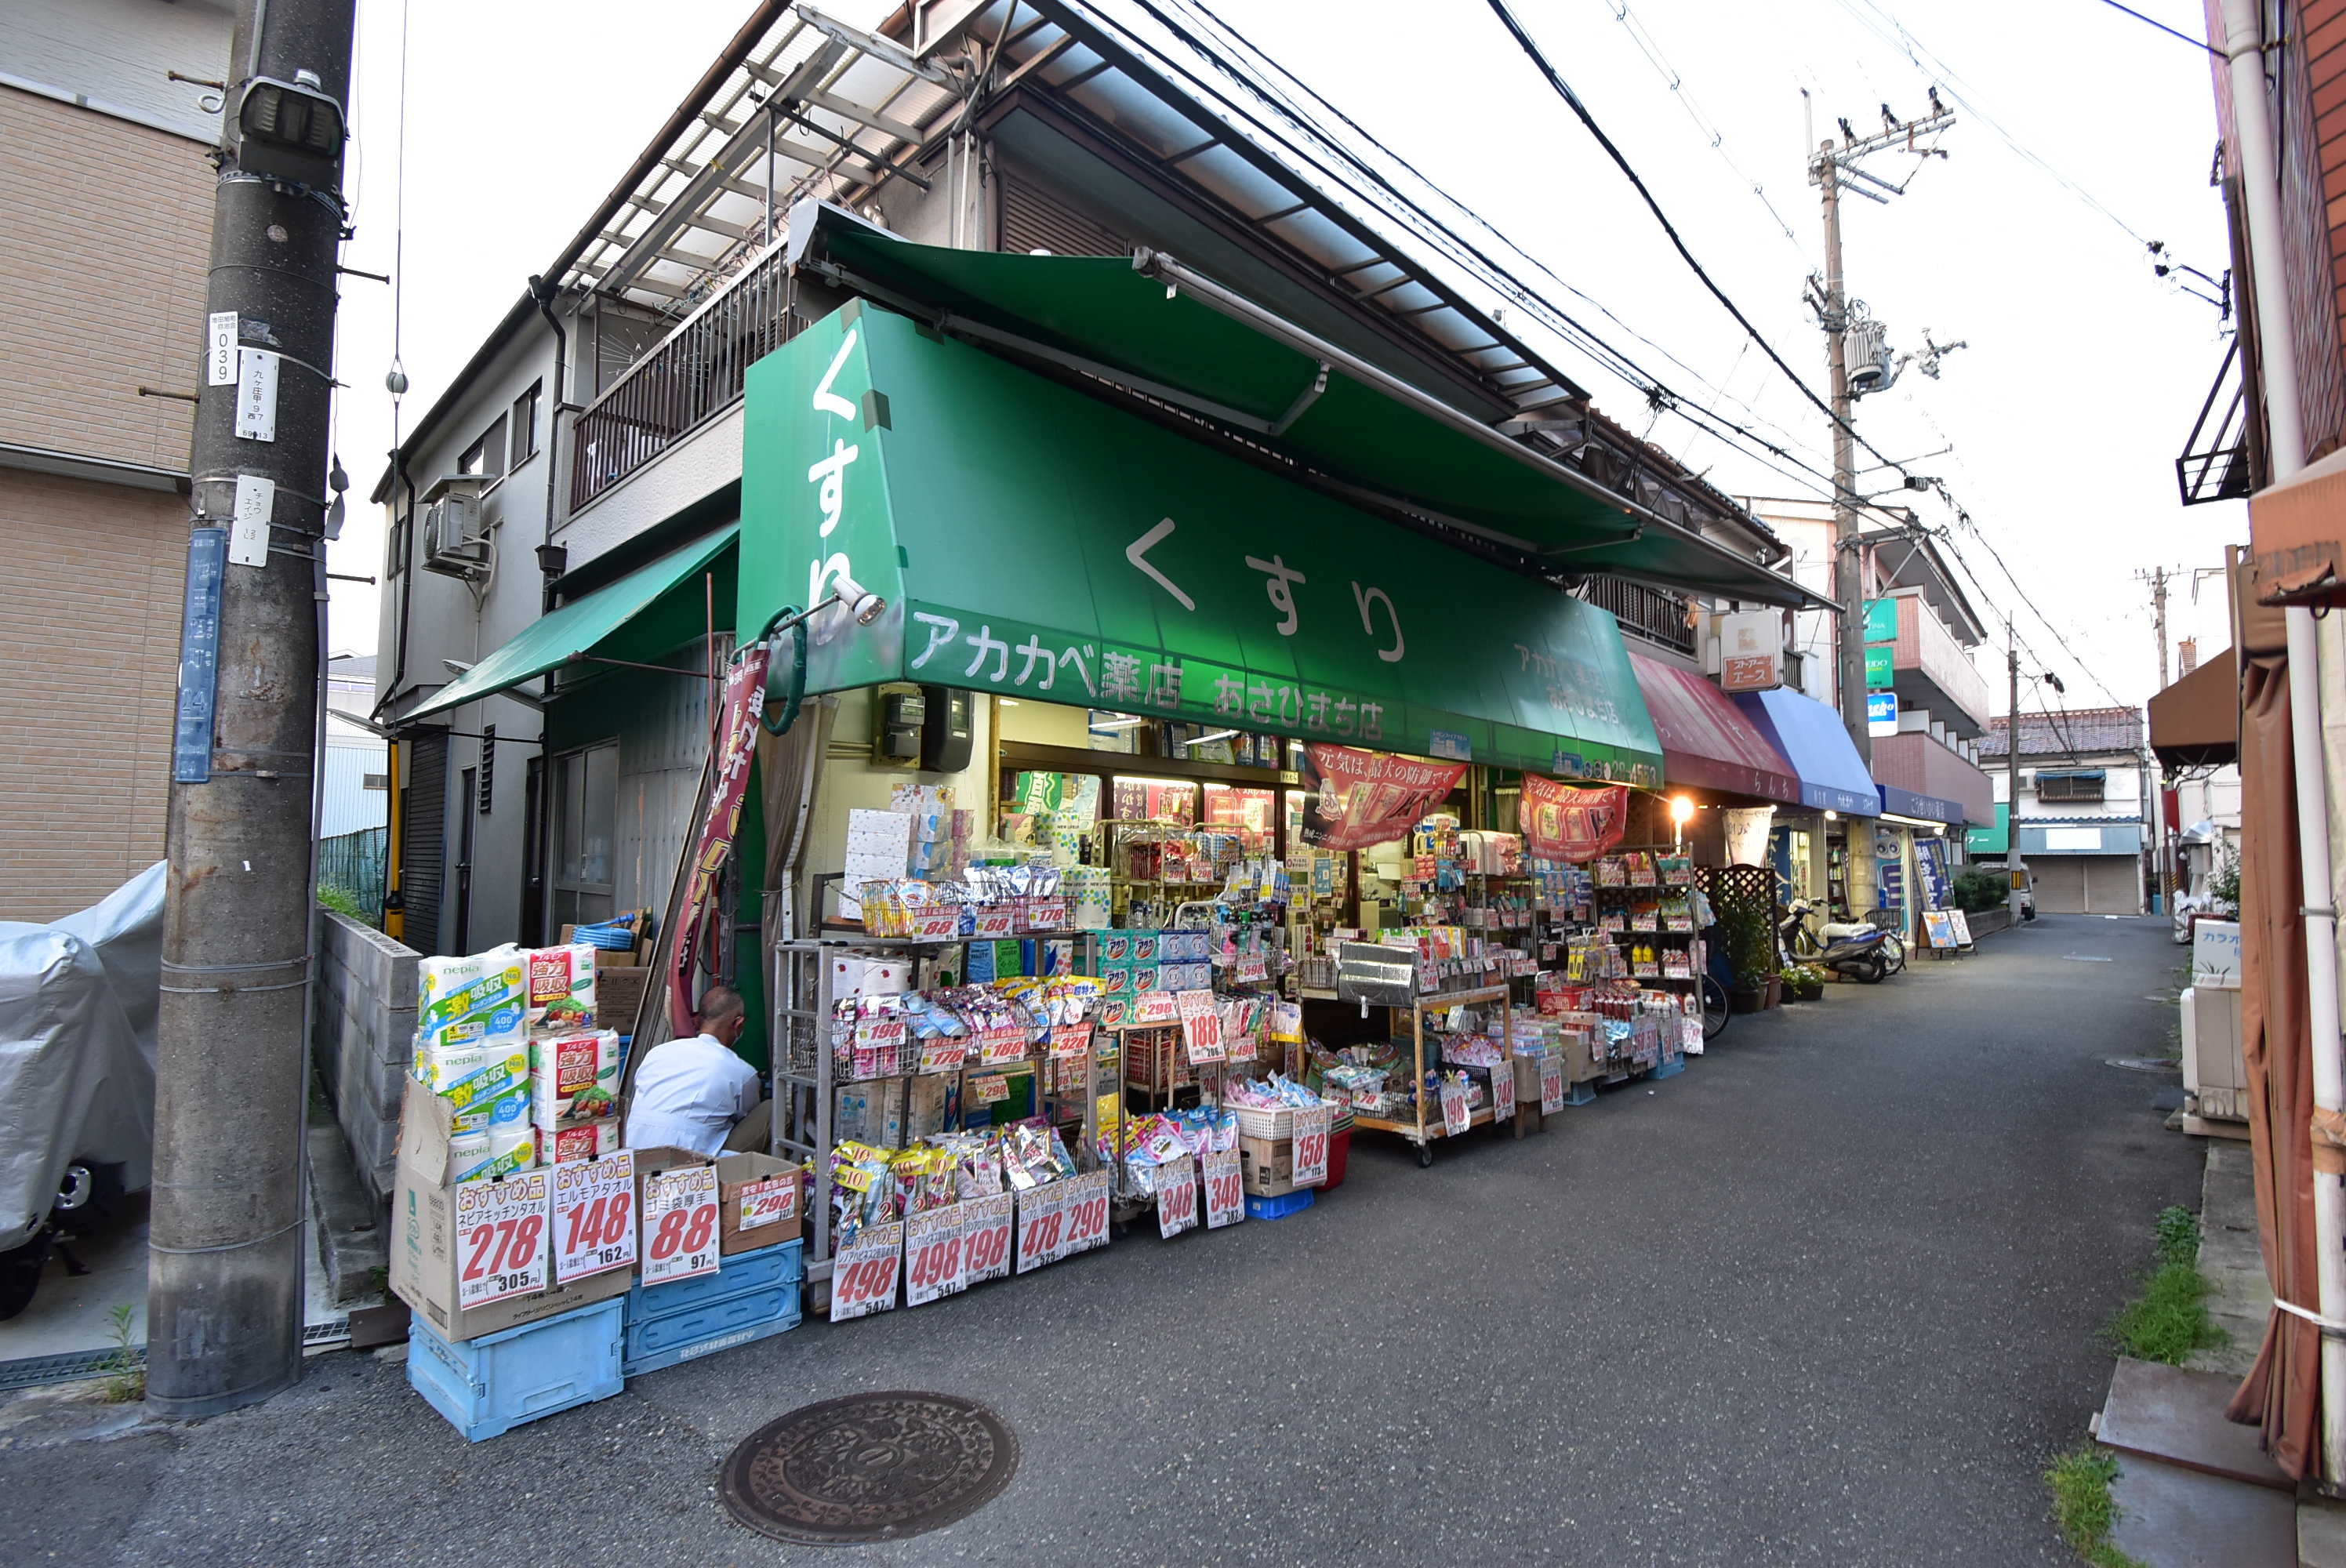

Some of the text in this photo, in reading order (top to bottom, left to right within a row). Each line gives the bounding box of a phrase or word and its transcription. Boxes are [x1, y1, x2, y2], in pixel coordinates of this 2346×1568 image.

[219, 333, 227, 379] 039
[808, 328, 859, 645] くすり
[254, 493, 263, 514] チョウ
[1126, 517, 1404, 662] くすり
[912, 612, 1183, 709] アカカベ薬店
[1733, 670, 1766, 683] エース
[182, 688, 207, 711] 24
[1214, 673, 1383, 741] あさひまち店
[1319, 746, 1453, 786] 元気は、最大の防御です
[1755, 771, 1788, 799] らんち
[984, 918, 1008, 931] 88
[1039, 909, 1064, 922] 178
[924, 920, 953, 935] 88
[444, 965, 479, 975] nepia
[532, 960, 566, 978] 強力
[1244, 964, 1264, 976] 598
[533, 976, 568, 993] 吸収
[1073, 985, 1097, 995] 超特大
[1147, 1003, 1172, 1015] 298
[1180, 992, 1215, 1007] おすすめ品
[870, 1022, 904, 1040] 198
[1189, 1015, 1218, 1047] 188
[993, 1041, 1024, 1057] 188
[1059, 1036, 1088, 1051] 328
[1236, 1044, 1255, 1057] 498
[446, 1054, 482, 1065] nepia
[558, 1049, 594, 1069] 強力
[932, 1049, 965, 1066] 178
[560, 1065, 594, 1084] 吸収
[985, 1084, 1006, 1097] 298
[1496, 1078, 1513, 1109] 248
[1543, 1075, 1560, 1103] 398
[499, 1105, 517, 1113] 400
[1295, 1109, 1325, 1128] おすすめ品
[1444, 1094, 1465, 1126] 198
[455, 1145, 490, 1158] nepia
[557, 1136, 594, 1156] 強力
[1298, 1133, 1325, 1169] 158
[1205, 1148, 1239, 1168] おすすめ品
[557, 1155, 631, 1190] おすすめ品
[1066, 1171, 1106, 1195] おすすめ品
[459, 1175, 545, 1212] おすすめ品
[557, 1179, 633, 1205] エルモアタオル
[646, 1169, 714, 1200] おすすめ品
[1211, 1174, 1240, 1212] 348
[646, 1193, 706, 1214] ゴミ袋厚手
[753, 1192, 794, 1216] 298
[1021, 1183, 1064, 1210] おすすめ品
[1162, 1181, 1193, 1225] 348
[458, 1201, 546, 1228] ネピアキッチンタオル
[565, 1192, 630, 1254] 148
[908, 1207, 962, 1237] おすすめ品
[1066, 1197, 1106, 1242] 298
[650, 1203, 717, 1261] 88
[1022, 1211, 1062, 1258] 478
[462, 1214, 543, 1282] 278
[965, 1225, 1008, 1272] 198
[1088, 1236, 1102, 1250] 327
[597, 1246, 622, 1265] 162
[691, 1254, 706, 1269] 97
[910, 1237, 961, 1289] 498
[1040, 1251, 1055, 1265] 525
[499, 1271, 529, 1292] 305
[837, 1257, 897, 1303] 498
[938, 1282, 956, 1298] 547
[866, 1301, 884, 1315] 547
